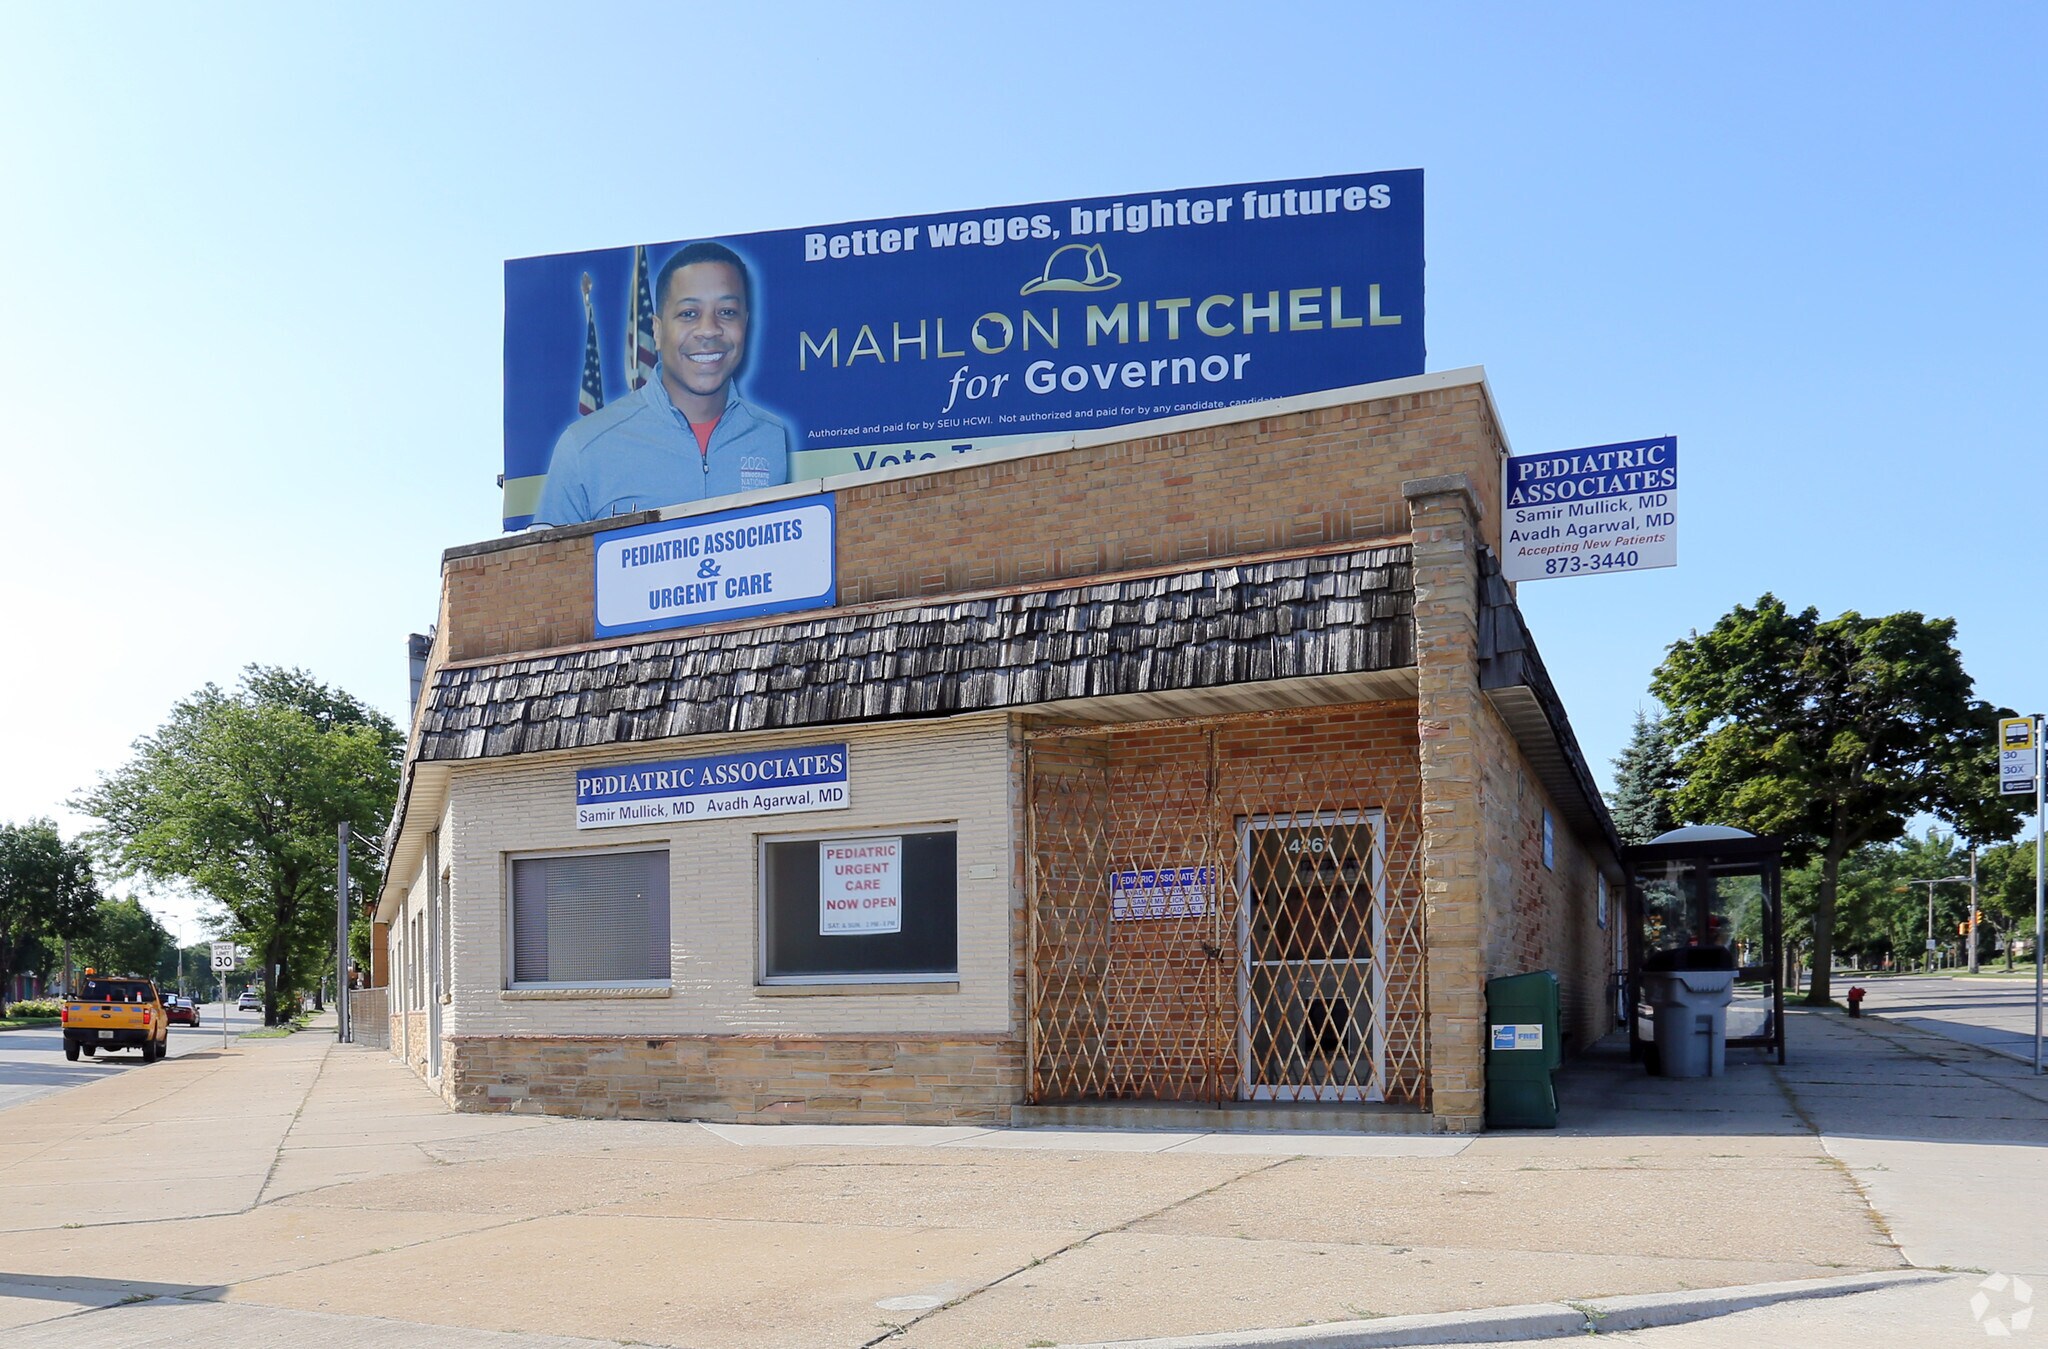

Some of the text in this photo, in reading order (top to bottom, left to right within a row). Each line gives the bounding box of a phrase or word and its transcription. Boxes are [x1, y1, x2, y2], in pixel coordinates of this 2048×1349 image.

[805, 184, 1391, 262] Better wages, brighter futures
[800, 283, 1402, 371] MAHLON MITCHELL
[941, 352, 1252, 414] for Governor
[808, 426, 860, 438] Authorized
[862, 425, 880, 435] and
[882, 422, 904, 434] paid
[906, 421, 920, 431] for
[922, 420, 935, 431] by
[937, 418, 960, 429] SEIU
[998, 414, 1017, 423] Not
[1019, 409, 1072, 422] authorized
[1075, 408, 1094, 418] and
[1096, 406, 1118, 417] paid
[1120, 405, 1135, 415] for
[1137, 405, 1151, 415] by
[1153, 403, 1172, 414] any
[1518, 445, 1666, 482] PEDIATRIC
[1509, 467, 1676, 505] ASSOCIATES
[1515, 493, 1668, 523] Samir Mullick, MD
[1509, 512, 1675, 544] Avadh Agarwal, MD
[621, 518, 803, 569] PEDIATRIC ASSOCIATES
[1517, 533, 1666, 557] Accepting New Patients
[696, 557, 722, 579] &
[1545, 550, 1639, 575] 873-3440
[649, 572, 773, 610] URGENT CARE
[2003, 751, 2017, 760] 30
[577, 752, 844, 798] PEDIATRIC ASSOCIATES
[2003, 765, 2025, 775] 30X
[579, 801, 695, 823] Samir Mullick, MD
[706, 787, 843, 813] Avadh Agarwal, MD
[826, 845, 896, 860] PEDIATRIC
[834, 862, 890, 876] URGENT
[845, 879, 881, 891] CARE
[826, 897, 897, 910] NOW OPEN
[215, 956, 232, 967] 30
